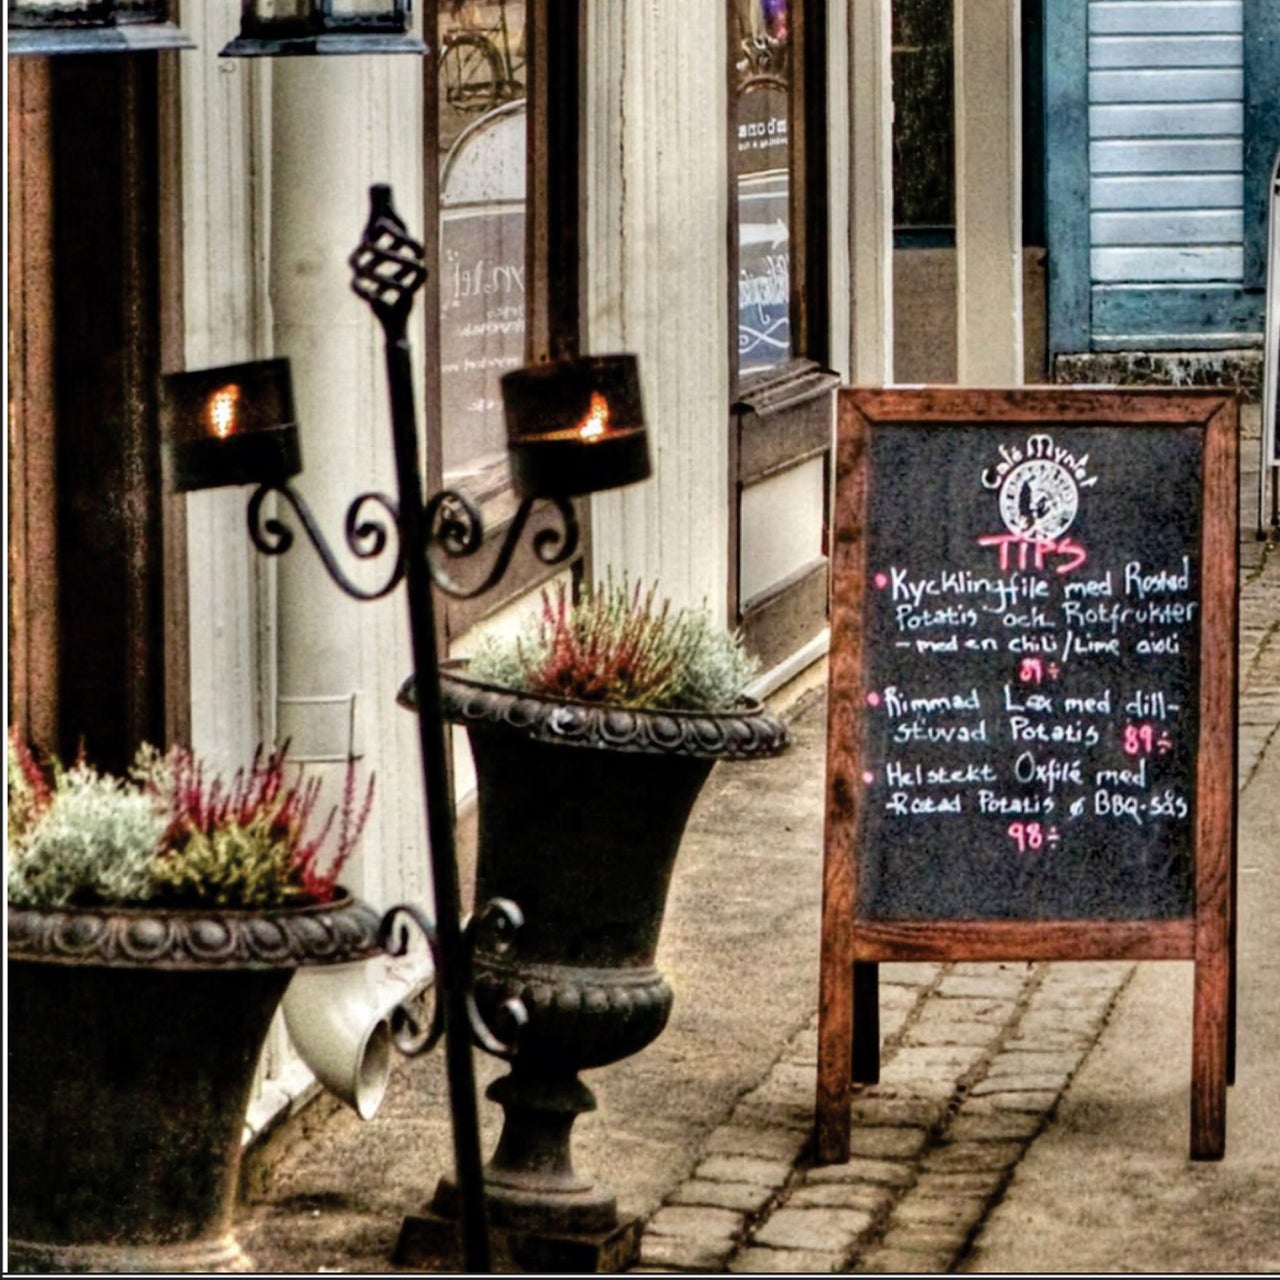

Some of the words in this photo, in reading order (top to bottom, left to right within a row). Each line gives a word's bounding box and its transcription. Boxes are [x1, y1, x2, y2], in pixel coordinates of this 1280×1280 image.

[980, 443, 1024, 490] Café
[1026, 433, 1099, 489] Myntet
[976, 536, 1088, 574] TIPS
[1063, 570, 1113, 599] med
[895, 603, 978, 632] Potatis
[1002, 606, 1056, 629] och
[1061, 600, 1200, 635] Rotfrukter
[916, 634, 959, 654] med
[964, 637, 998, 652] en
[884, 685, 981, 718] Rimmad
[1064, 688, 1111, 714] med
[893, 718, 988, 743] stuvad
[1010, 716, 1100, 747] Potatis
[1014, 750, 1084, 793] Oxfilé
[1095, 757, 1146, 789] med
[977, 788, 1055, 814] Potatis
